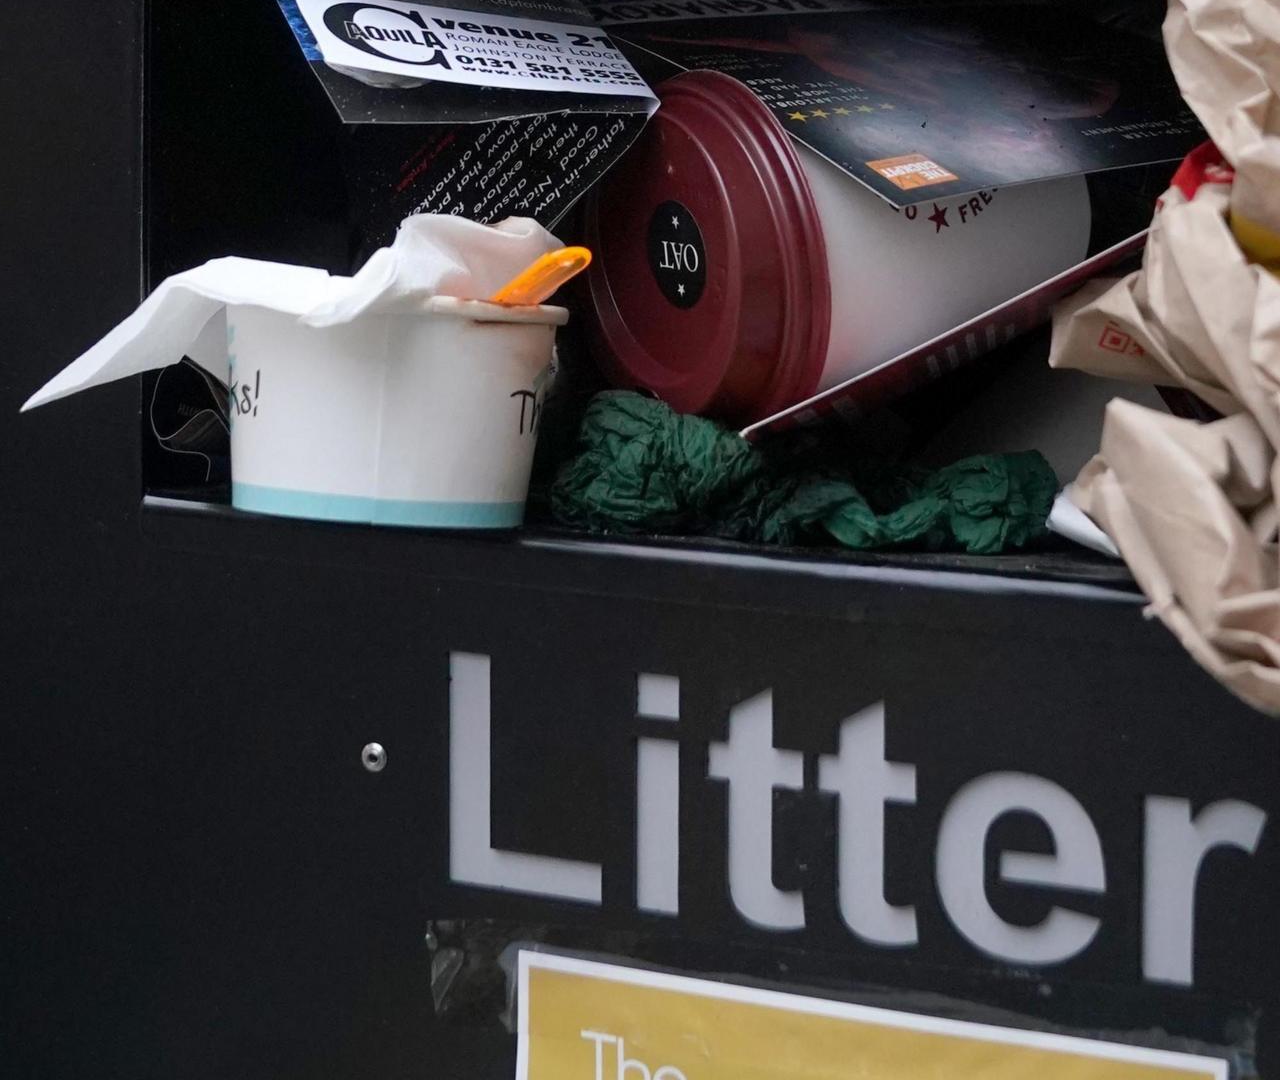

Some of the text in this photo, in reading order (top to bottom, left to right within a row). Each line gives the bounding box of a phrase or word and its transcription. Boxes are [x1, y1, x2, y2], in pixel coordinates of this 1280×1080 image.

[344, 21, 447, 49] AQUILA
[431, 17, 617, 50] venue 21
[445, 32, 624, 61] ROMAN EAGLE LODGE
[454, 44, 635, 71] JOHNSTON TERRACE
[456, 54, 641, 81] 0131 581 5555
[795, 89, 830, 99] MOST
[475, 120, 500, 151] rrel
[475, 115, 548, 189] fast-paced,
[487, 119, 520, 158] show
[548, 122, 578, 159] their
[456, 161, 482, 192] that
[459, 150, 472, 171] of
[473, 122, 558, 214] they explore
[514, 125, 598, 210] Good Nick,
[534, 118, 625, 216] father-in-law
[958, 189, 999, 224] FRE
[660, 240, 699, 273] OAT
[228, 364, 261, 417] ks!
[448, 651, 1267, 986] Litter
